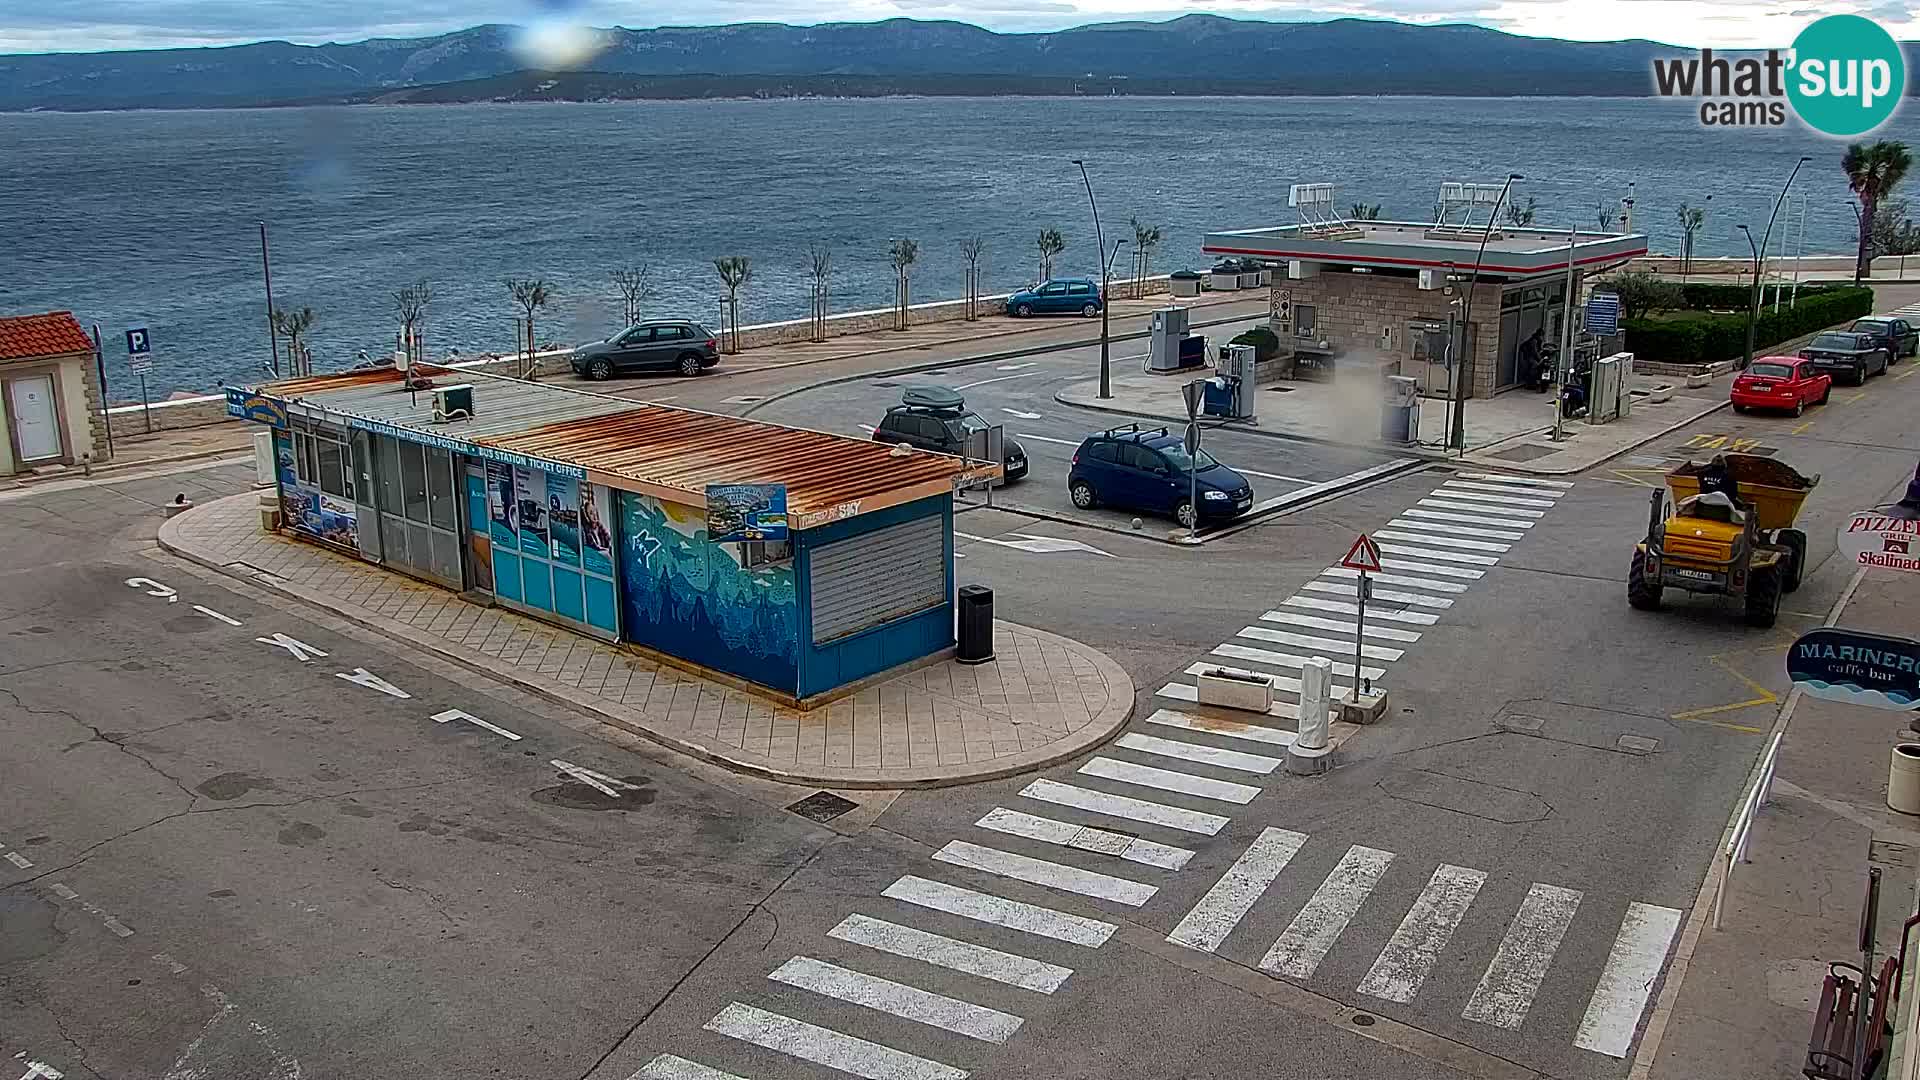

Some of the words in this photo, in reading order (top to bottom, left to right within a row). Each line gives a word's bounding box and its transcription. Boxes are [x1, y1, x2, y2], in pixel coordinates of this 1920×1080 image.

[131, 331, 144, 351] P
[1684, 433, 1762, 453] TAXI
[437, 437, 469, 453] POSTAJA
[479, 446, 494, 459] BUS
[495, 450, 527, 466] STATION
[528, 458, 556, 473] TICKET
[555, 464, 583, 478] OFFICE
[1880, 532, 1917, 542] GRILL
[1828, 663, 1864, 677] caffe
[1869, 667, 1896, 682] bar
